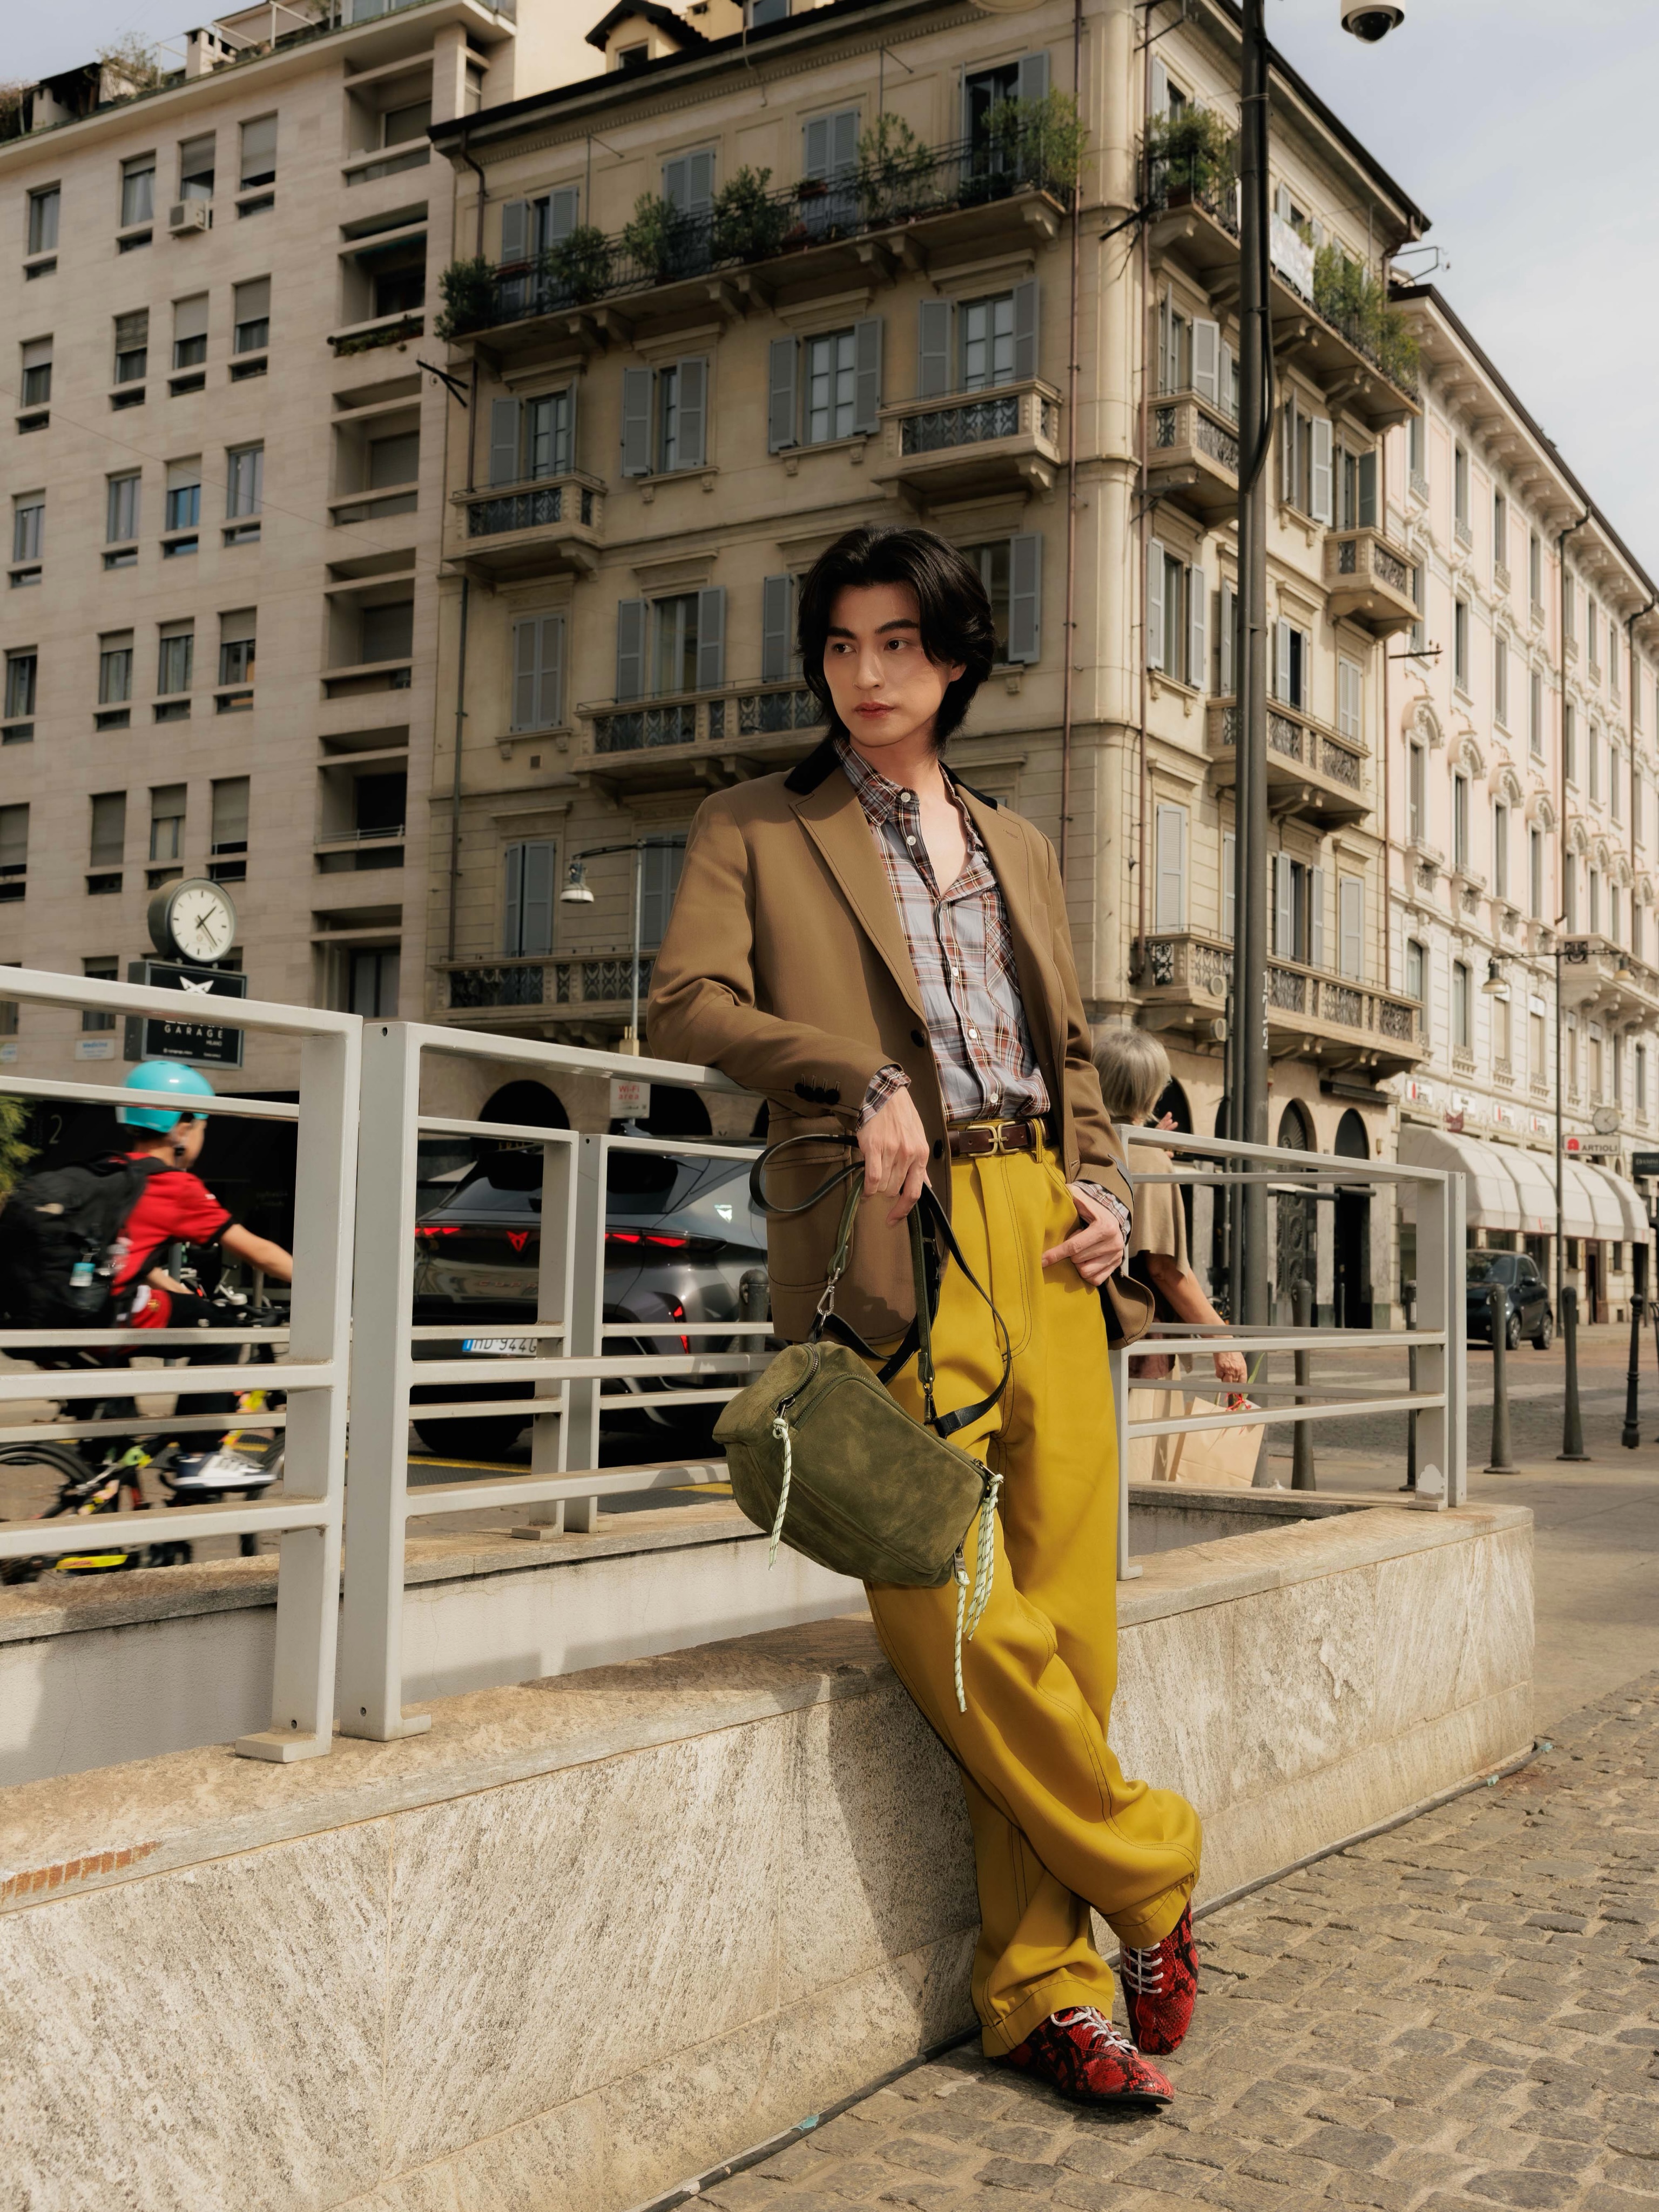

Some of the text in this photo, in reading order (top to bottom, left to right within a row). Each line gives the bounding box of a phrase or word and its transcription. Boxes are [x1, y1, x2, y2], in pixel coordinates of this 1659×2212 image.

[164, 1024, 223, 1039] GARAGE
[618, 1084, 640, 1092] Wi-Fi
[49, 1114, 62, 1144] 2
[1582, 1144, 1617, 1152] ARTIOLI
